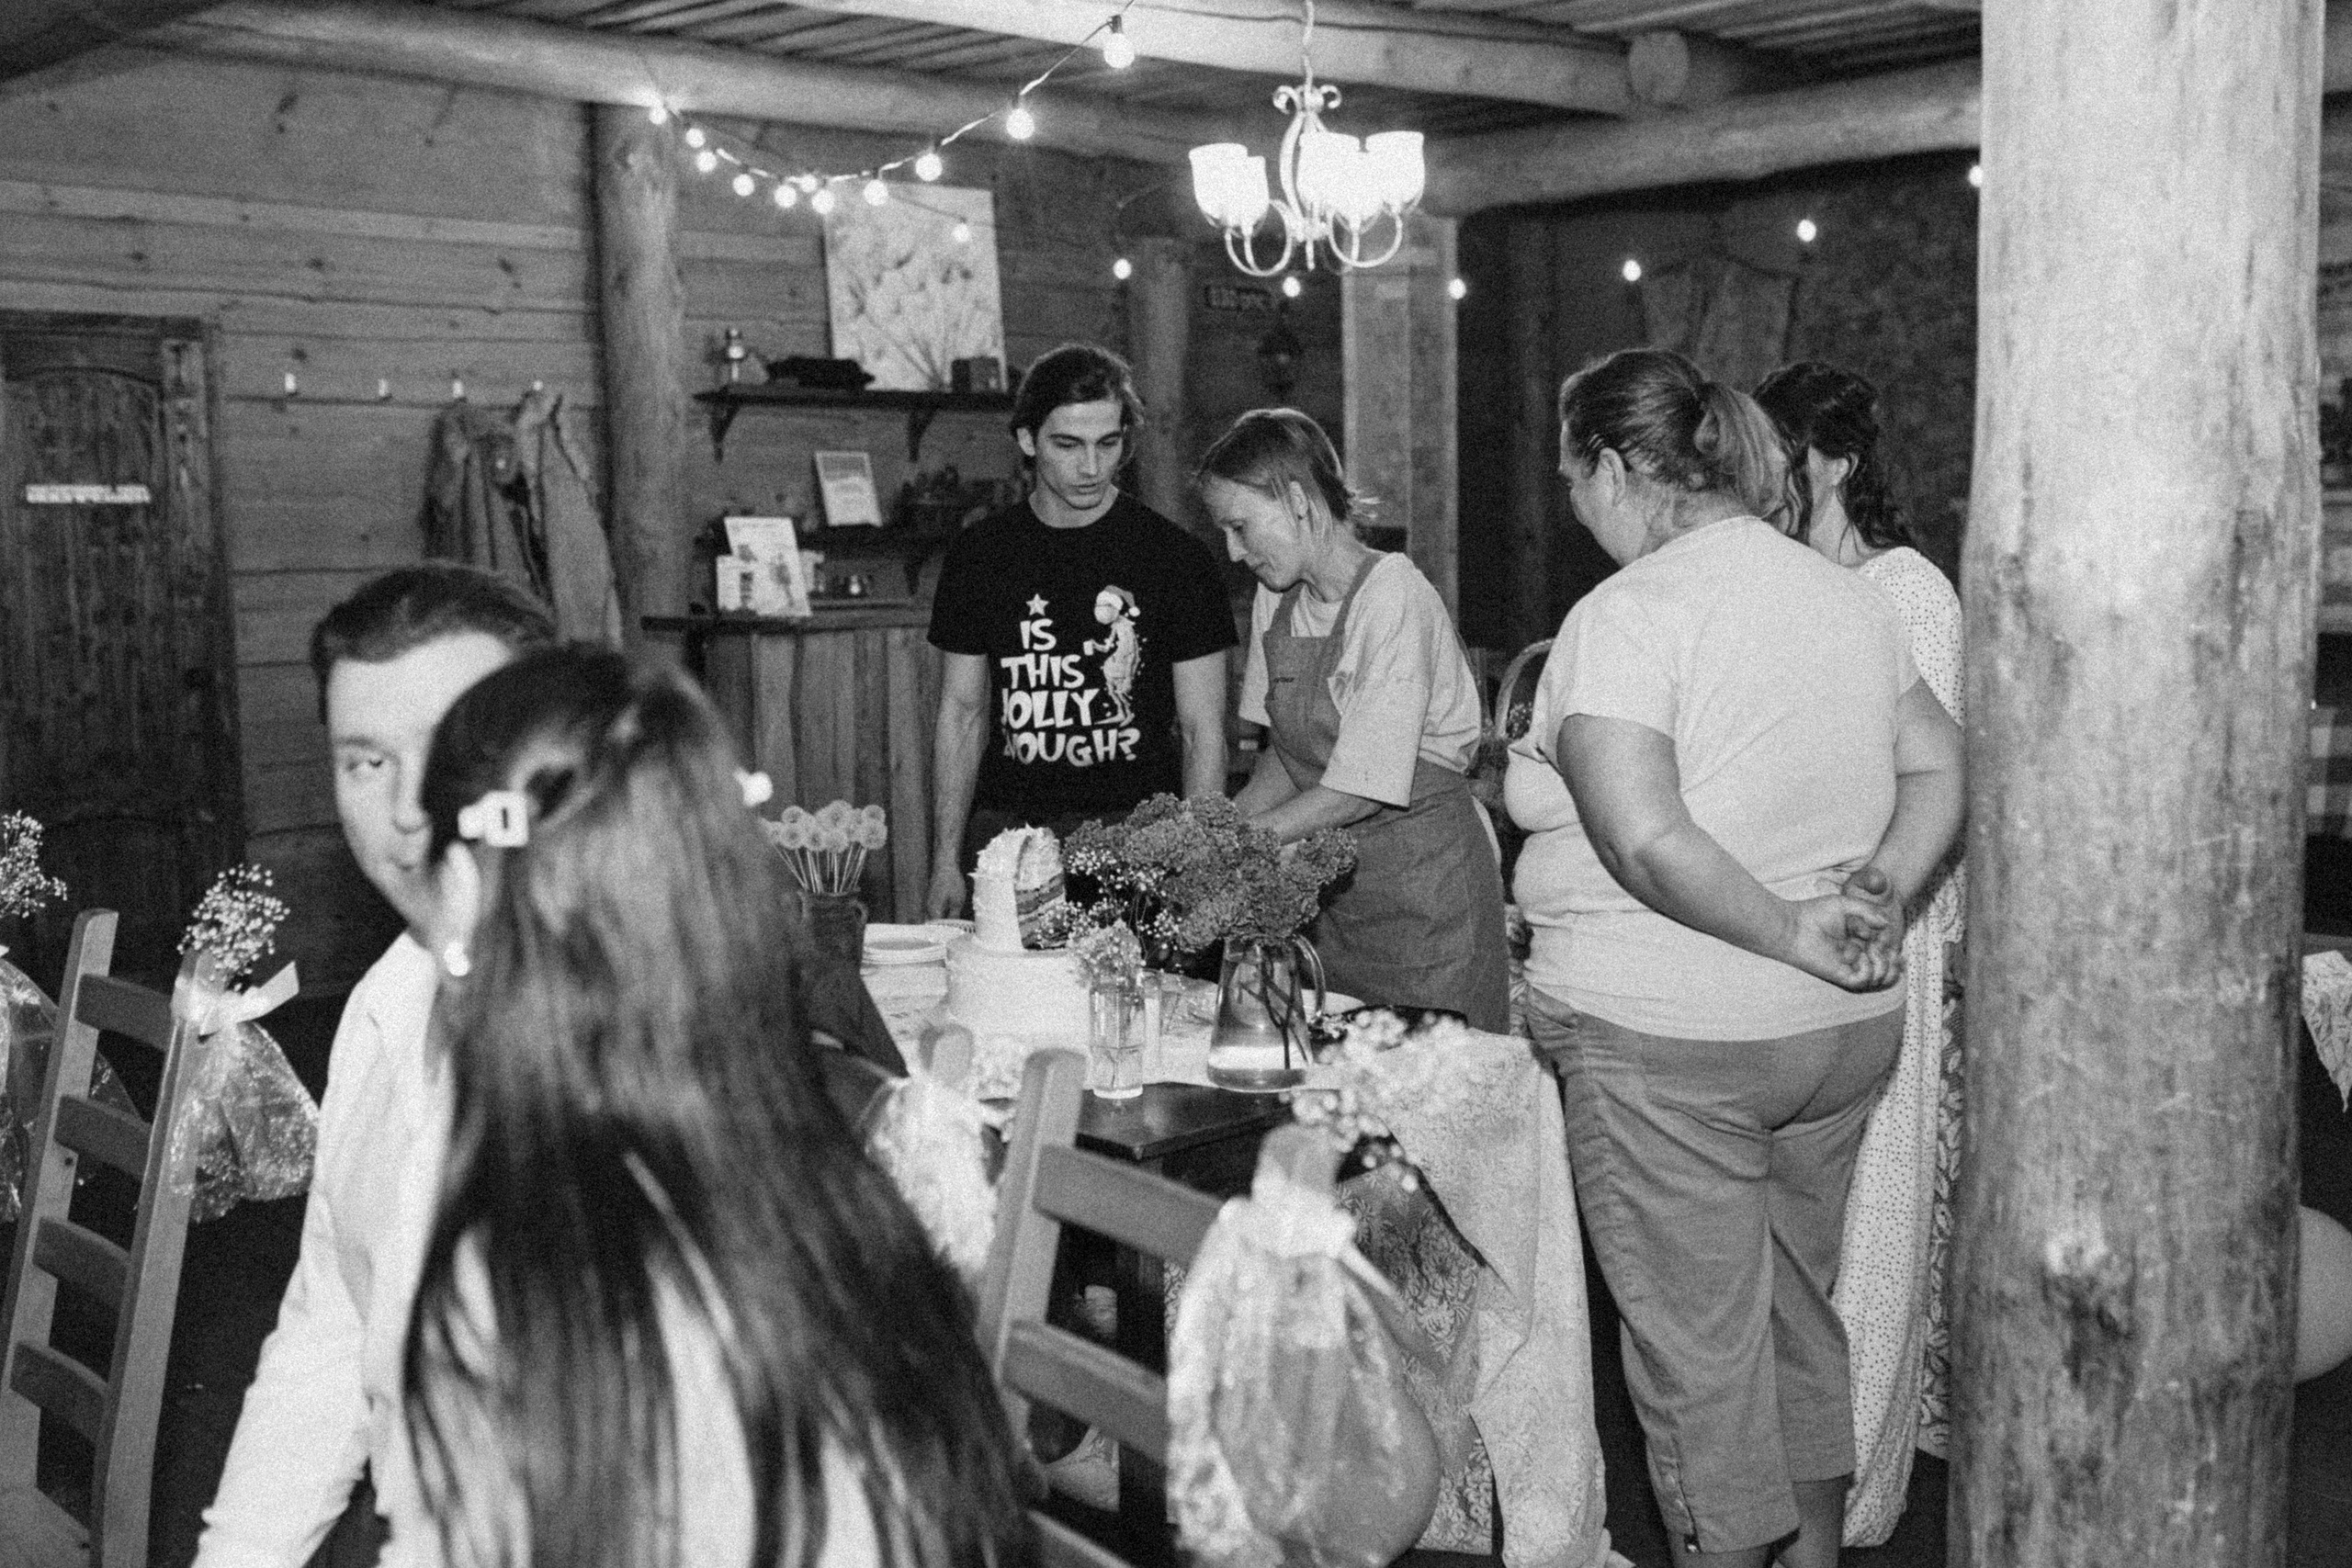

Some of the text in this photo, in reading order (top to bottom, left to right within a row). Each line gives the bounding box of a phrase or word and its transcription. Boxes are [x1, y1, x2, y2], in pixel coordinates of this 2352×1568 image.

[1020, 618, 1057, 651] IS
[1001, 653, 1085, 689] THIS
[1002, 728, 1141, 767] NOUGH?
